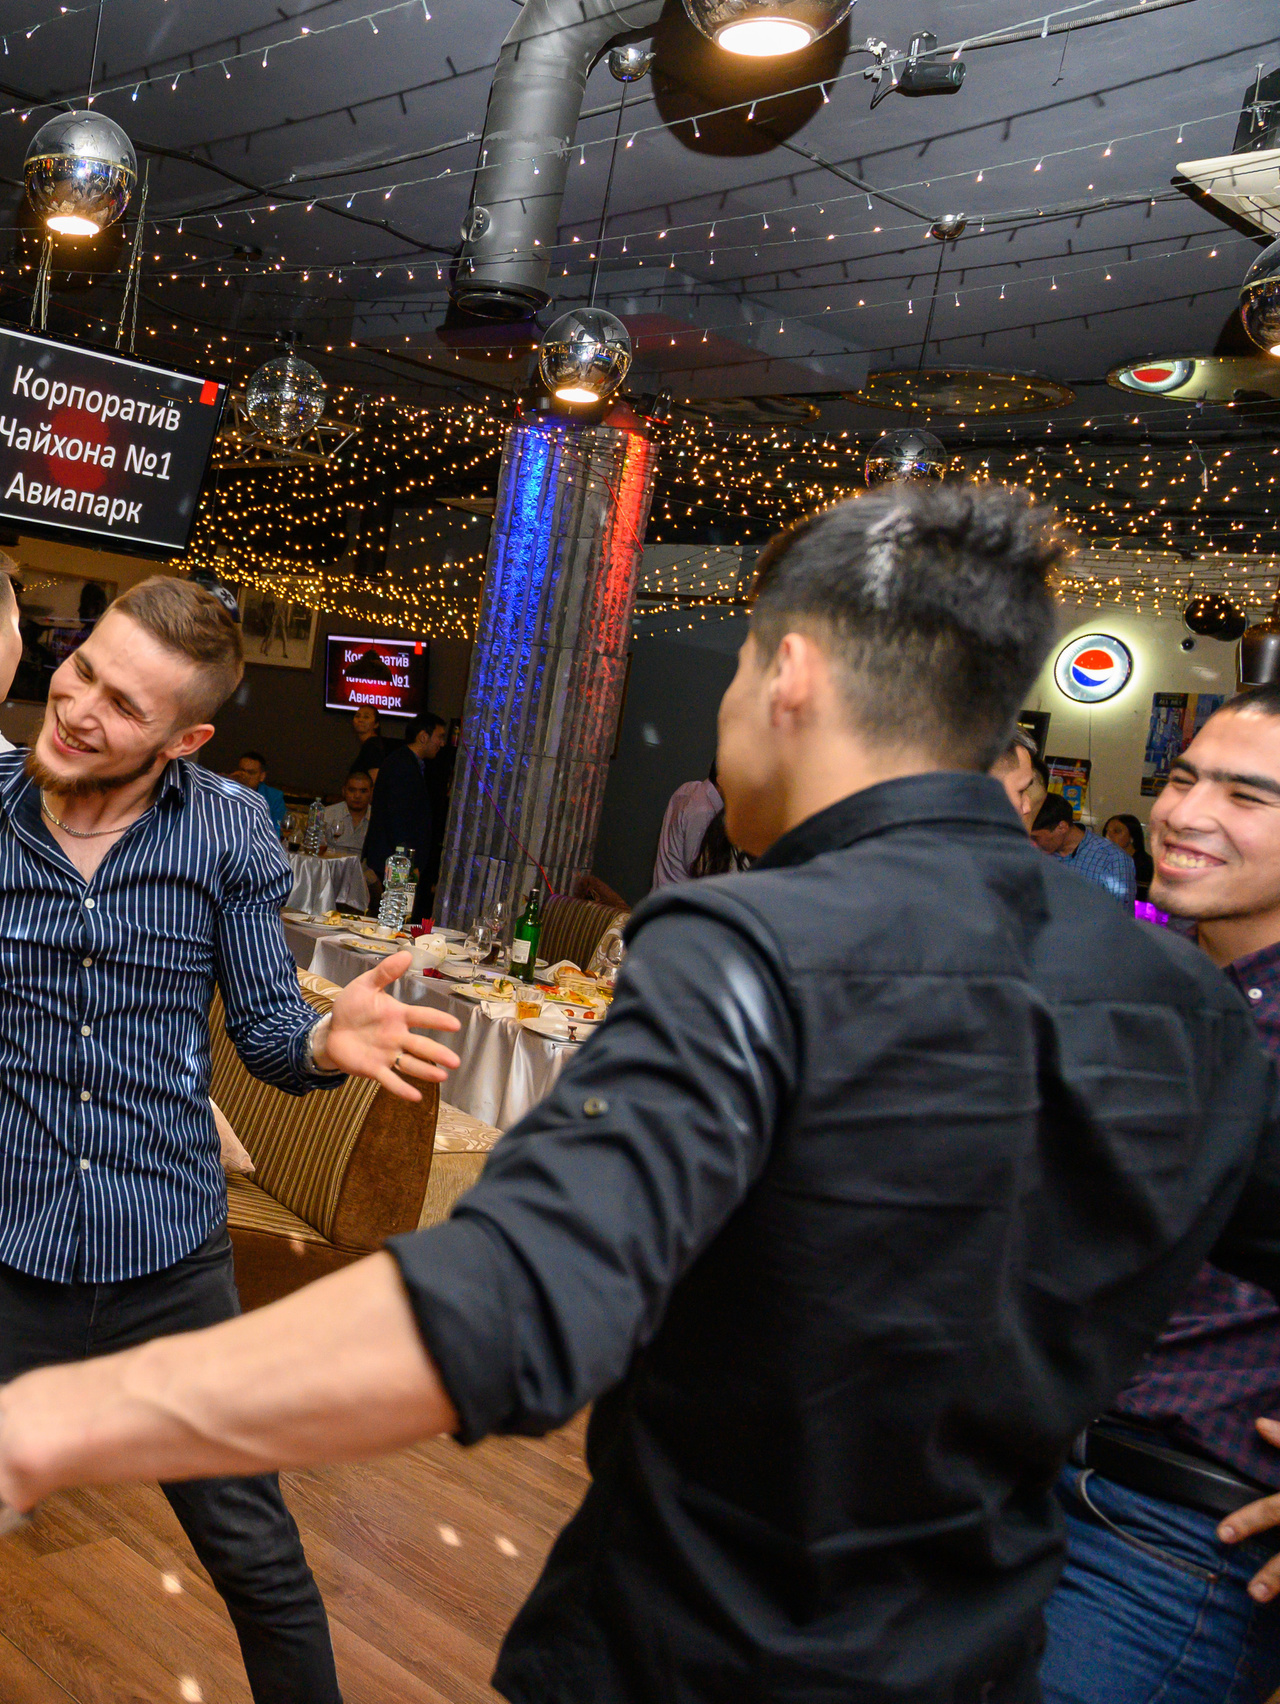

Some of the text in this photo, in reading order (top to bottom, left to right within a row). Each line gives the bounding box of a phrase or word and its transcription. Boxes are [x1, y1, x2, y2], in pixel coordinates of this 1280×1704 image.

[12, 364, 181, 431] Корпоратив
[123, 443, 172, 481] №1
[4, 471, 143, 526] Авиапарк
[344, 649, 410, 668] Коатив
[390, 674, 410, 688] №1
[348, 689, 402, 709] Авиапарк
